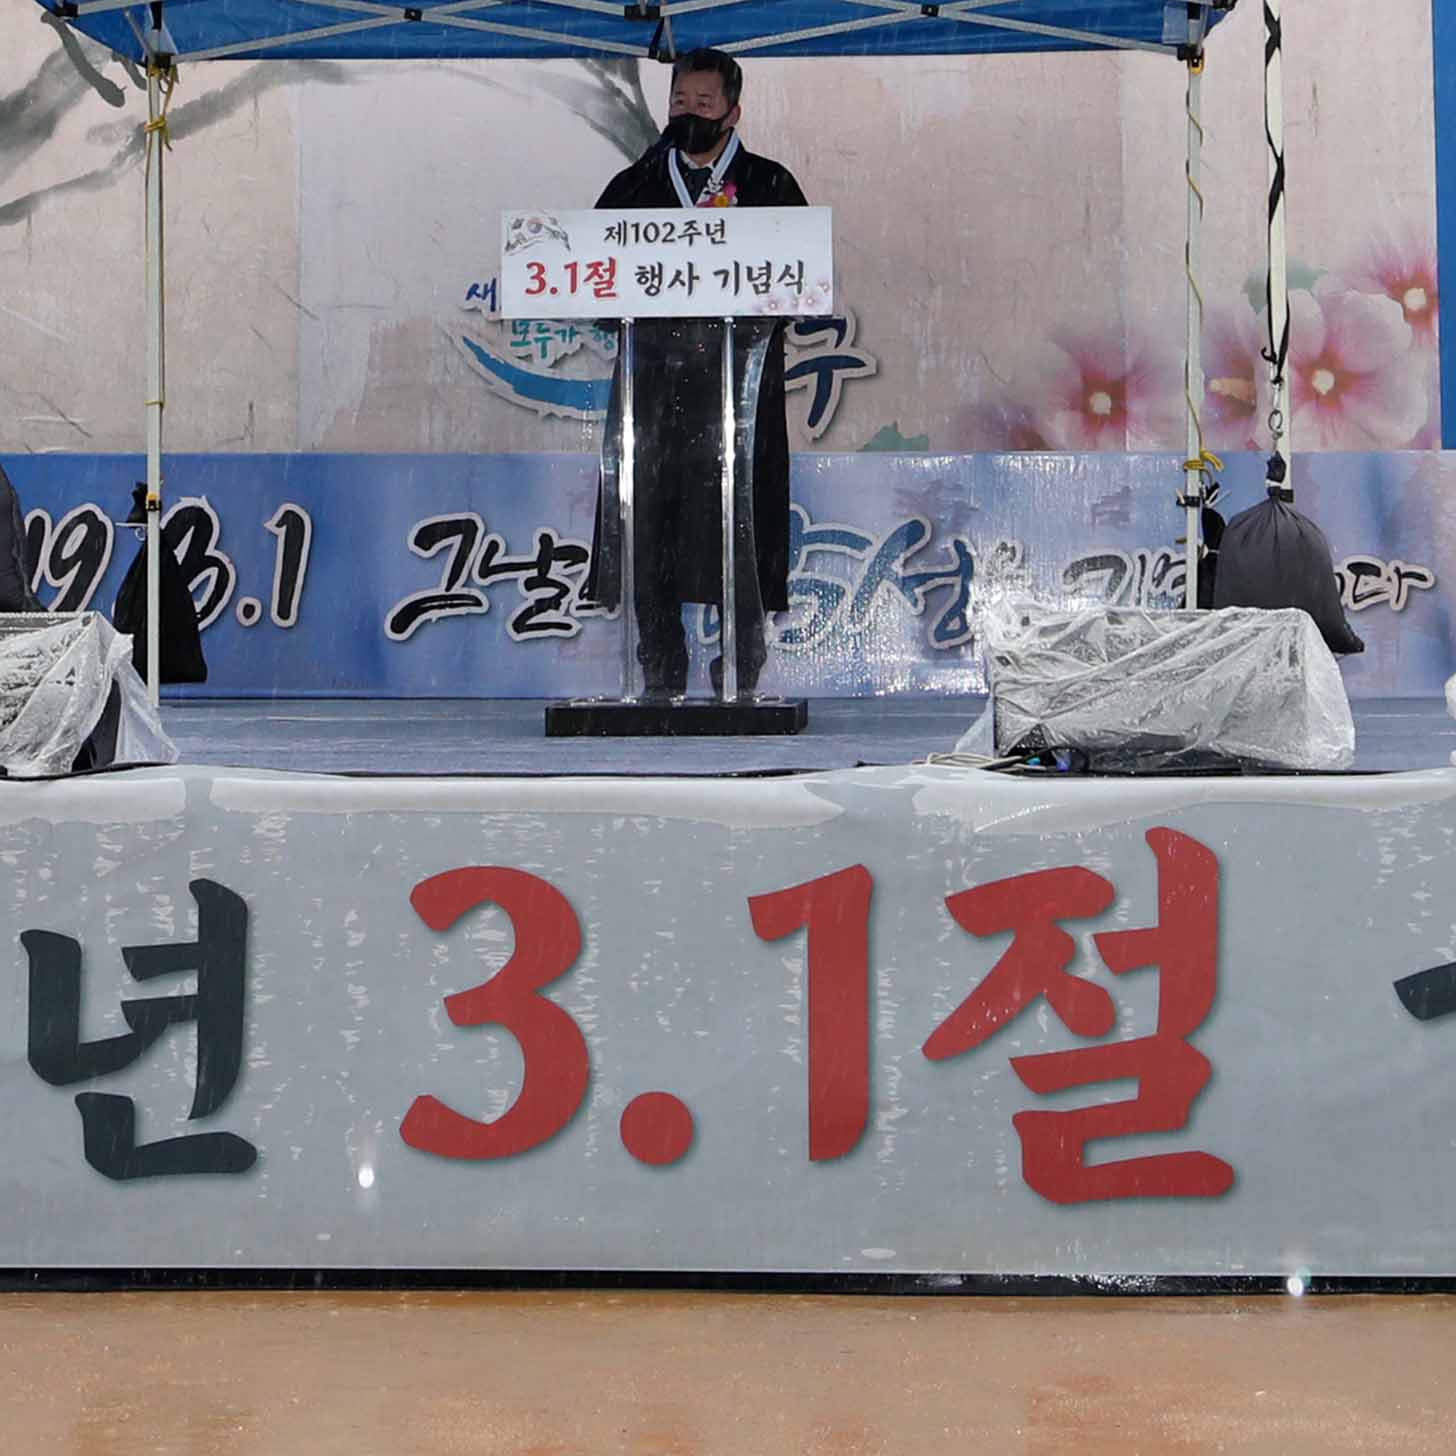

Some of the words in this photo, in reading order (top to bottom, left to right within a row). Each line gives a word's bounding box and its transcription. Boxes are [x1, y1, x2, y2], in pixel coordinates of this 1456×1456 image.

[603, 218, 727, 248] 제102주년
[525, 257, 618, 298] 3.1절
[634, 261, 701, 298] 행사
[712, 260, 806, 298] 기념식
[511, 319, 580, 359] 모두가
[785, 318, 867, 430] 구
[399, 826, 1235, 1205] 3.1절
